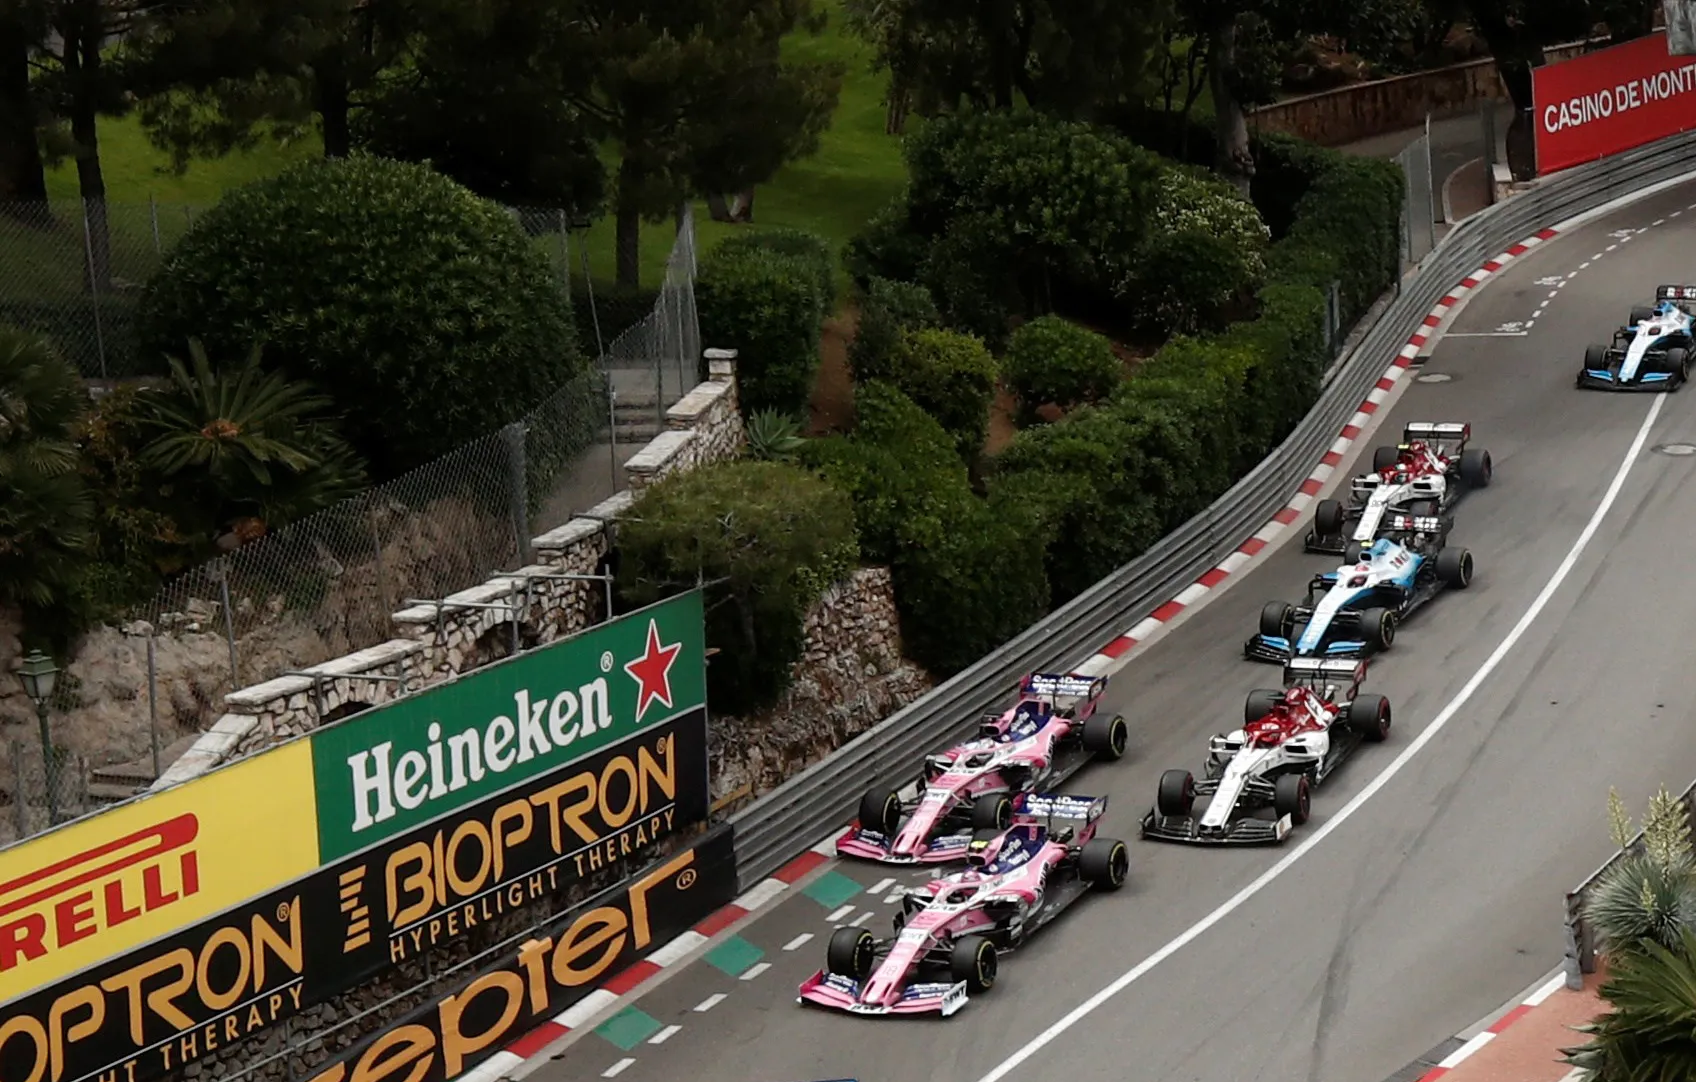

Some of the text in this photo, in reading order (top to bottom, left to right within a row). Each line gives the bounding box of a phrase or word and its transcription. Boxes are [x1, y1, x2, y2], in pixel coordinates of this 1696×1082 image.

[1544, 89, 1613, 132] CASINO
[1615, 81, 1641, 112] DE
[346, 673, 613, 832] Heineken
[386, 732, 676, 930] BIOPTRON
[389, 801, 676, 964] HYPERLIGHT THERAPY
[159, 982, 304, 1071] THERAPY
